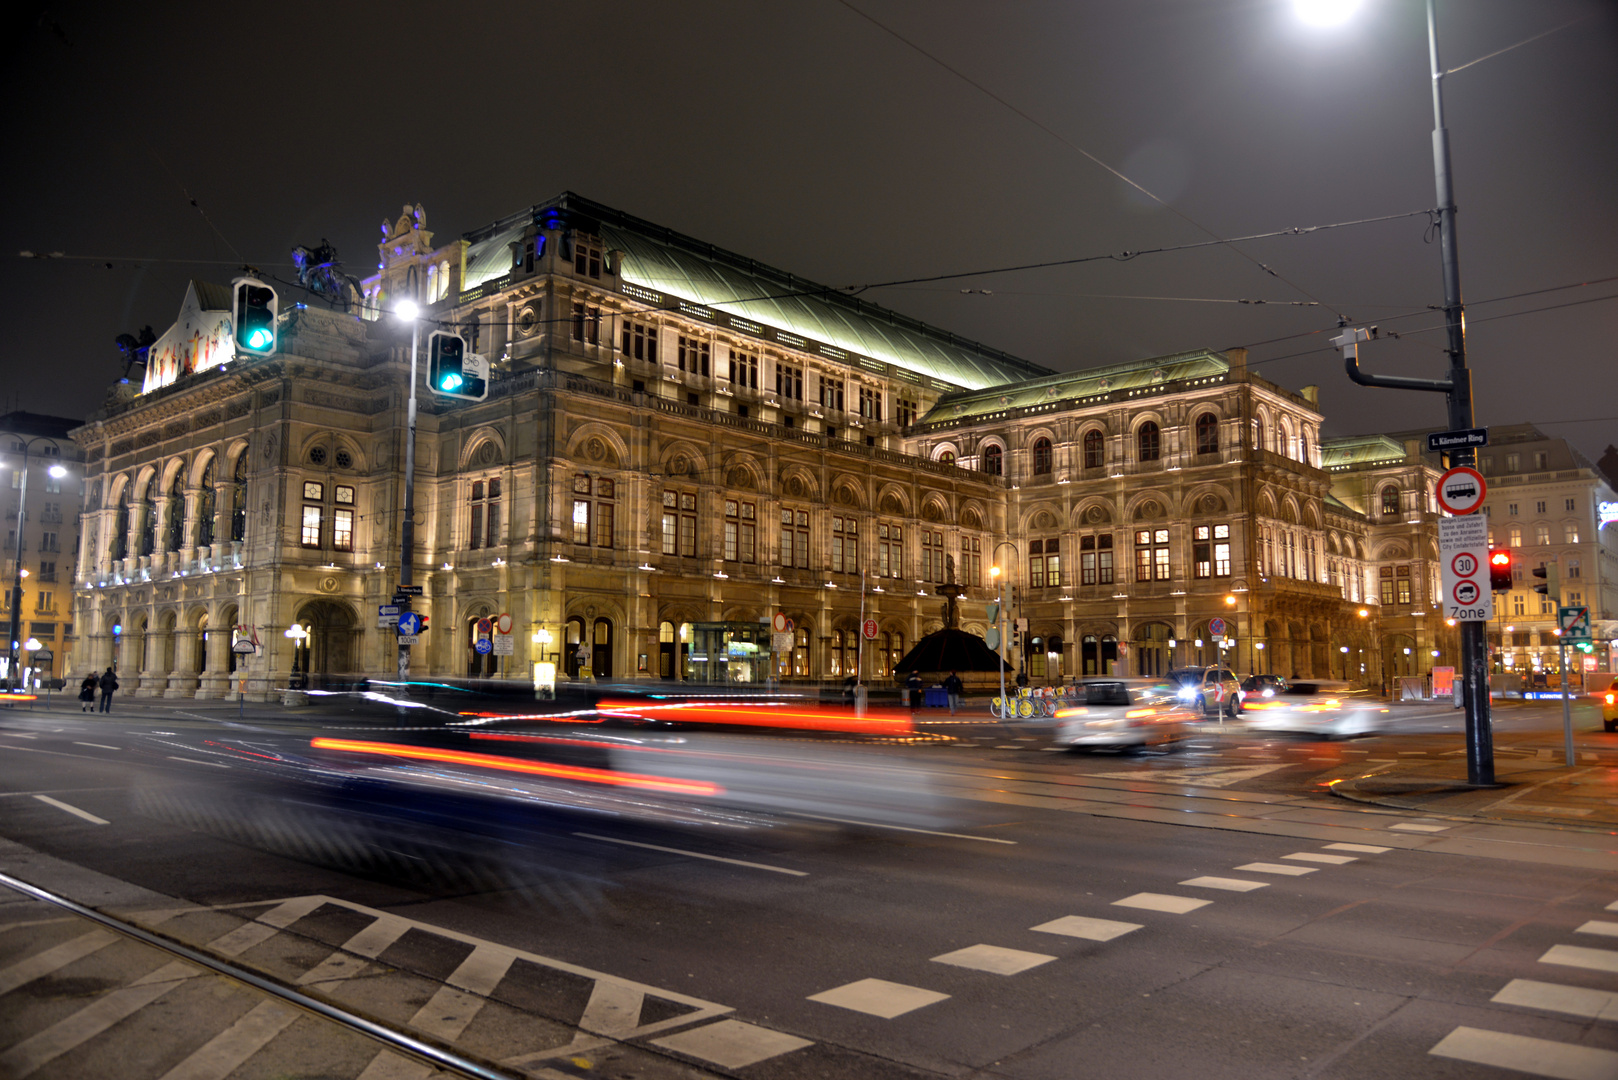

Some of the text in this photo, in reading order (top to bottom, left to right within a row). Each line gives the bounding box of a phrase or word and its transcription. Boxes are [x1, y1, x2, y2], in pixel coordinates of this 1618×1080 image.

[1468, 434, 1483, 443] Ring
[1458, 559, 1471, 572] 30
[1450, 606, 1485, 619] Zone
